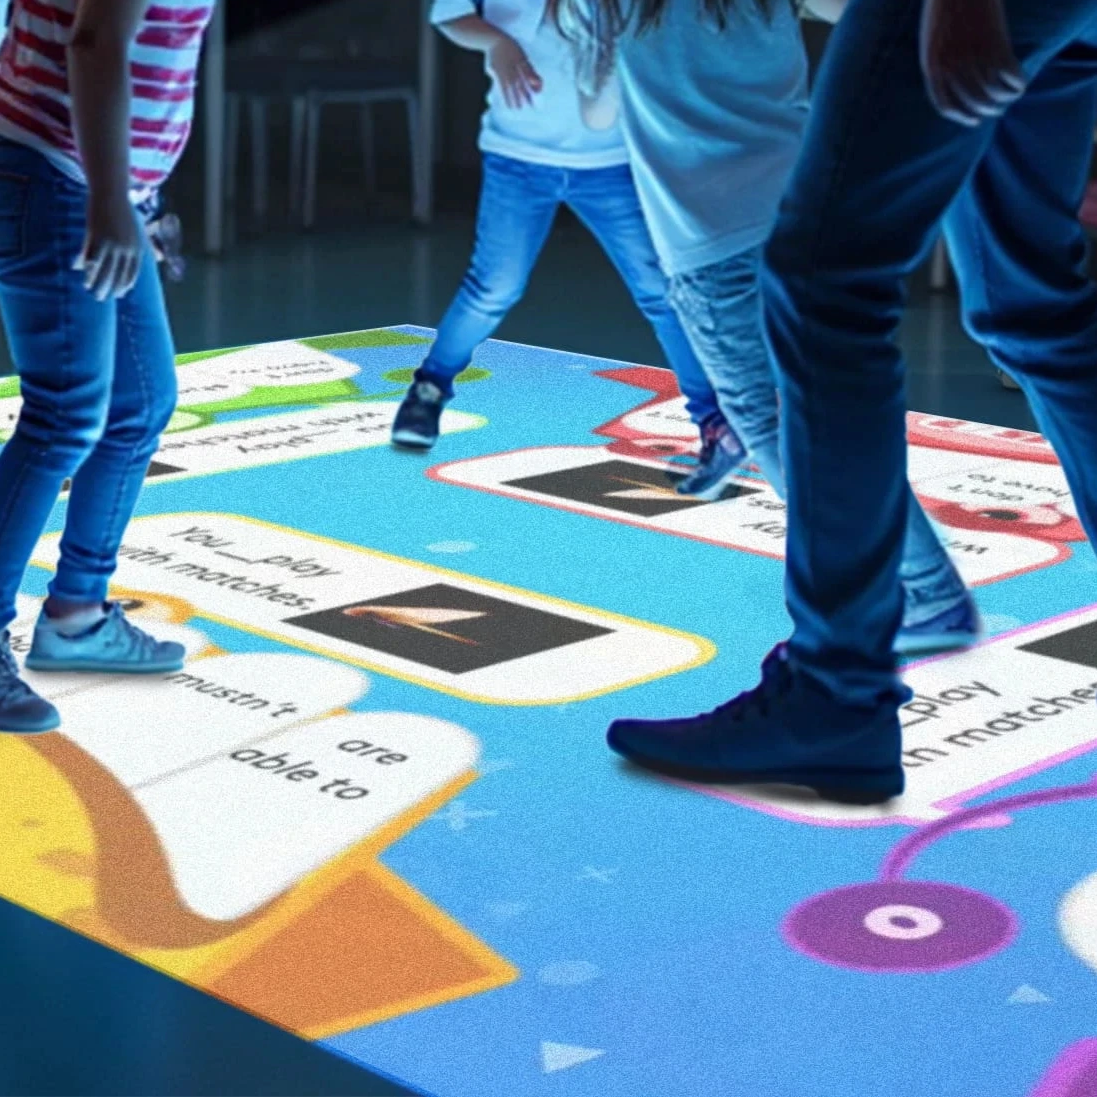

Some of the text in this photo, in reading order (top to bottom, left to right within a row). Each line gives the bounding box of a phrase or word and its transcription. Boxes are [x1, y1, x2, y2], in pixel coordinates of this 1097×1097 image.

[166, 671, 299, 719] mustn't
[943, 681, 1097, 748] matche
[230, 744, 369, 800] able to
[337, 736, 408, 766] are
